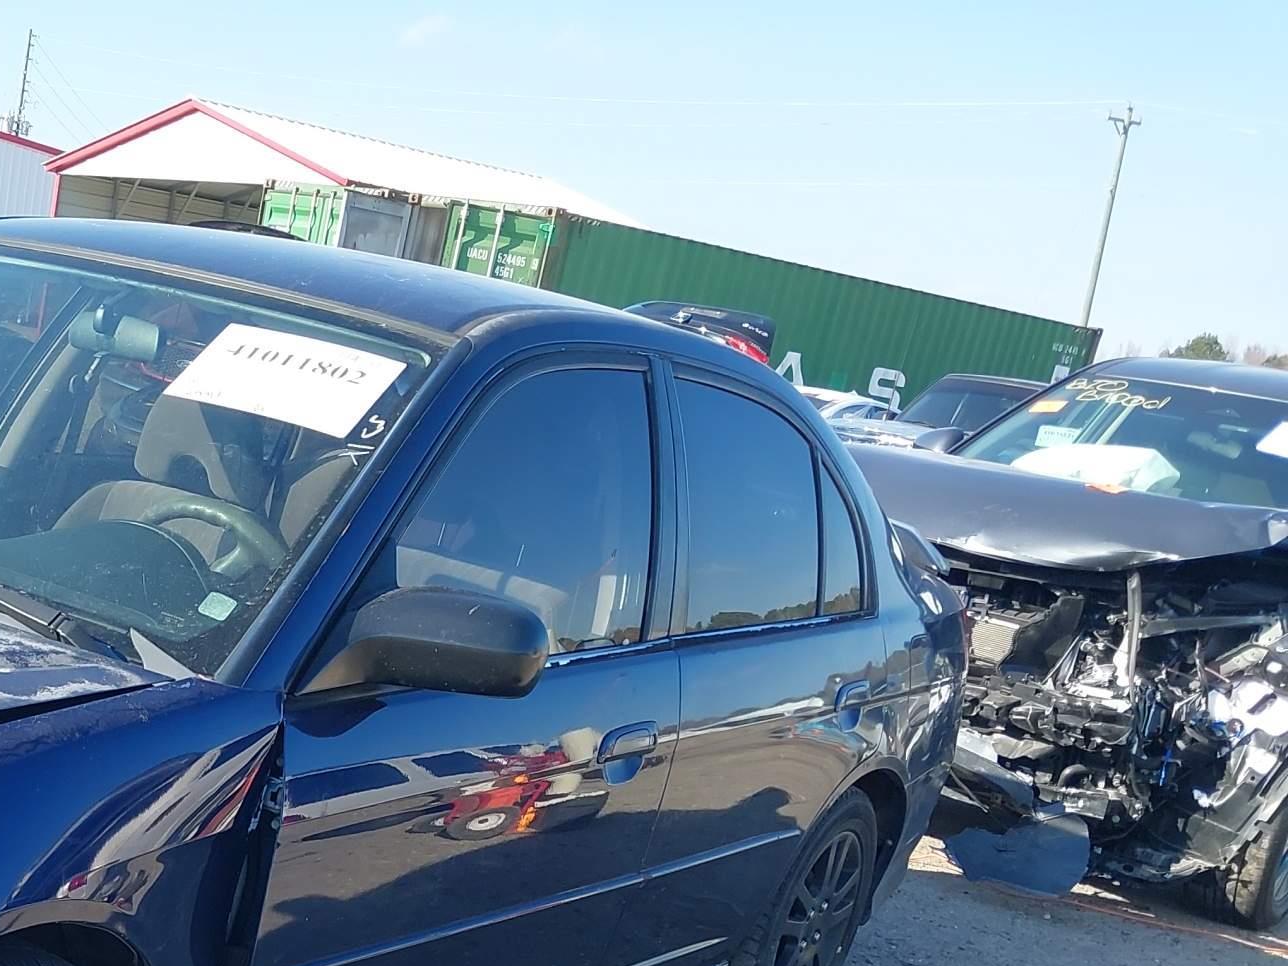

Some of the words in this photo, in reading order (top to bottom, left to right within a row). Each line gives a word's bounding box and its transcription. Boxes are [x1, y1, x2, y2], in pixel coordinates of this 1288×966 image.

[467, 247, 488, 260] UACU
[497, 252, 526, 267] 524495
[227, 344, 367, 385] 41011802
